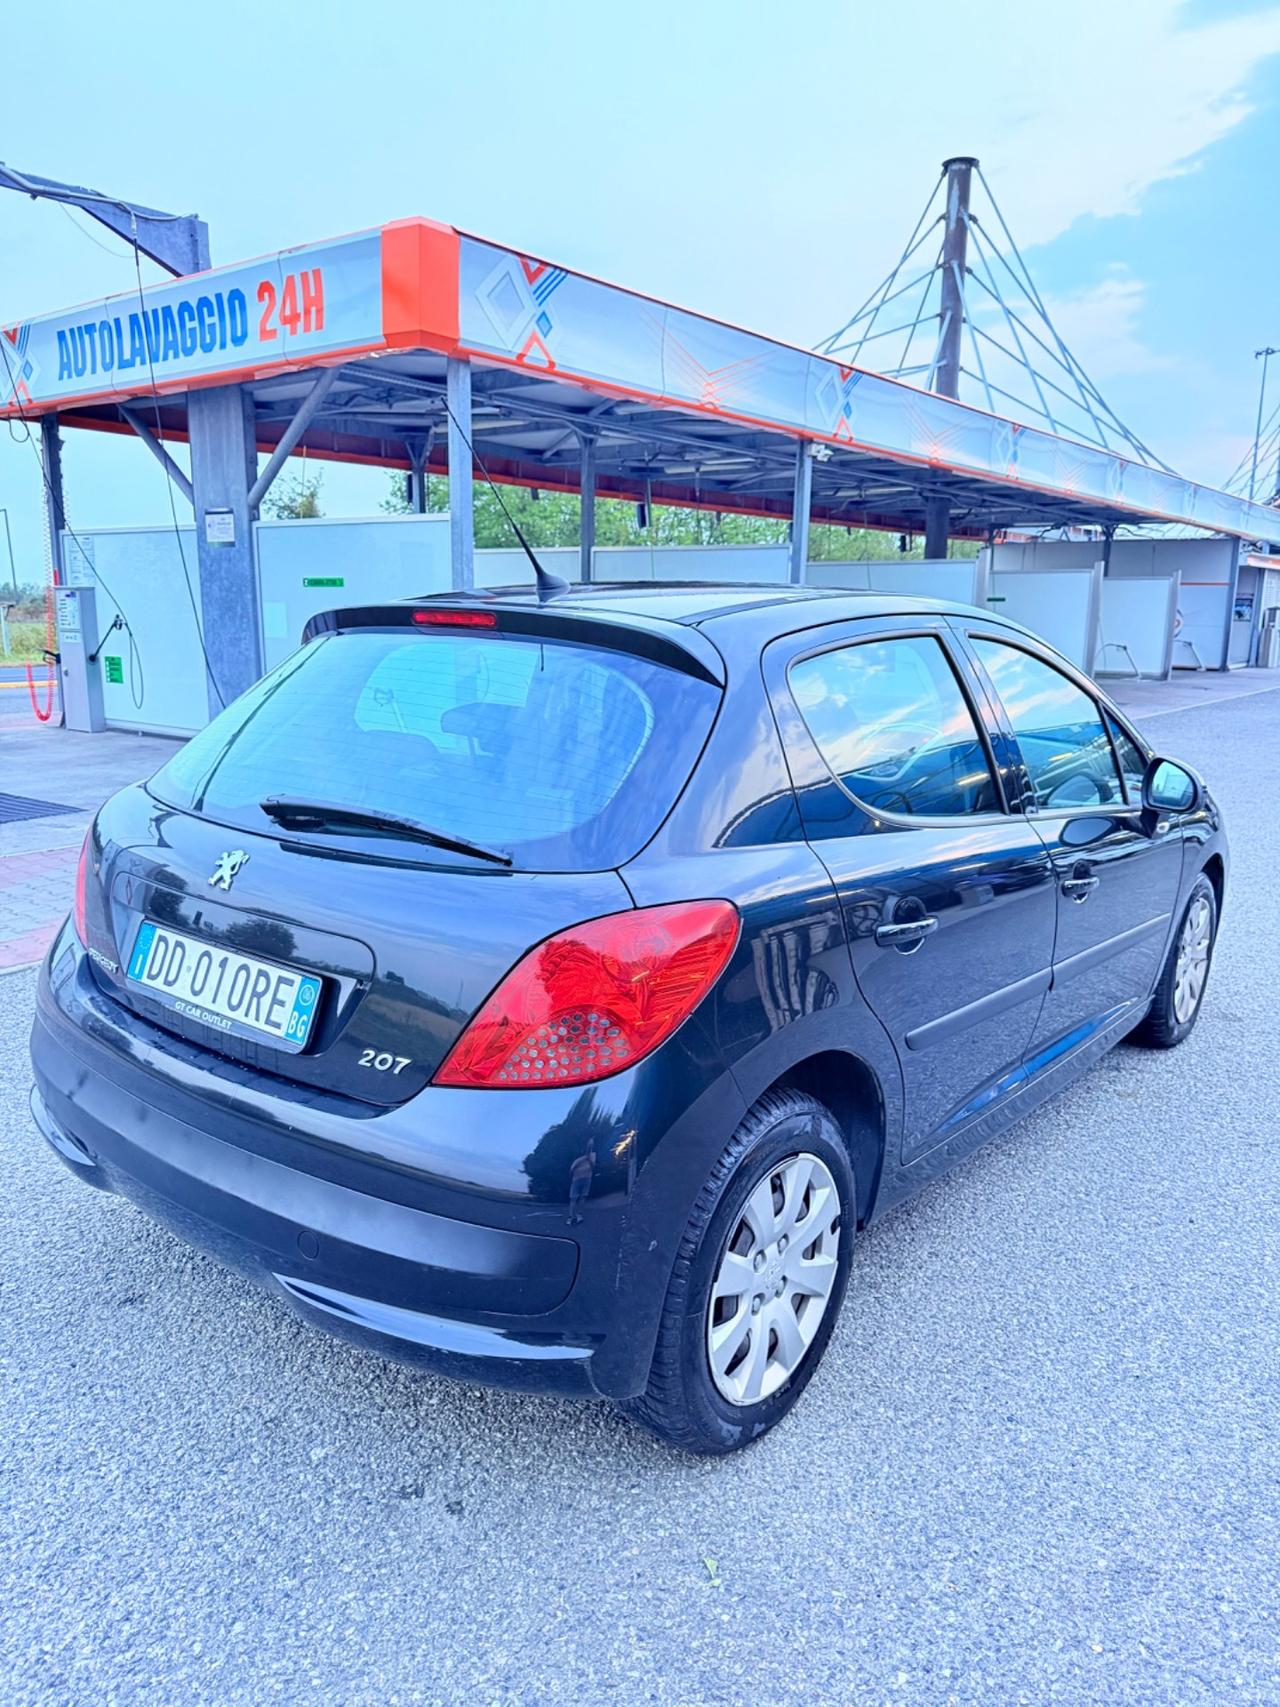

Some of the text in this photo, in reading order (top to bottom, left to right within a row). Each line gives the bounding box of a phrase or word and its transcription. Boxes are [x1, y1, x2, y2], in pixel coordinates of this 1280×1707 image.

[57, 268, 324, 381] AUTOLAVAGGIO 24H
[175, 1001, 232, 1030] GT CAR OUTLET
[287, 1011, 308, 1038] BG
[357, 1049, 412, 1075] 207
